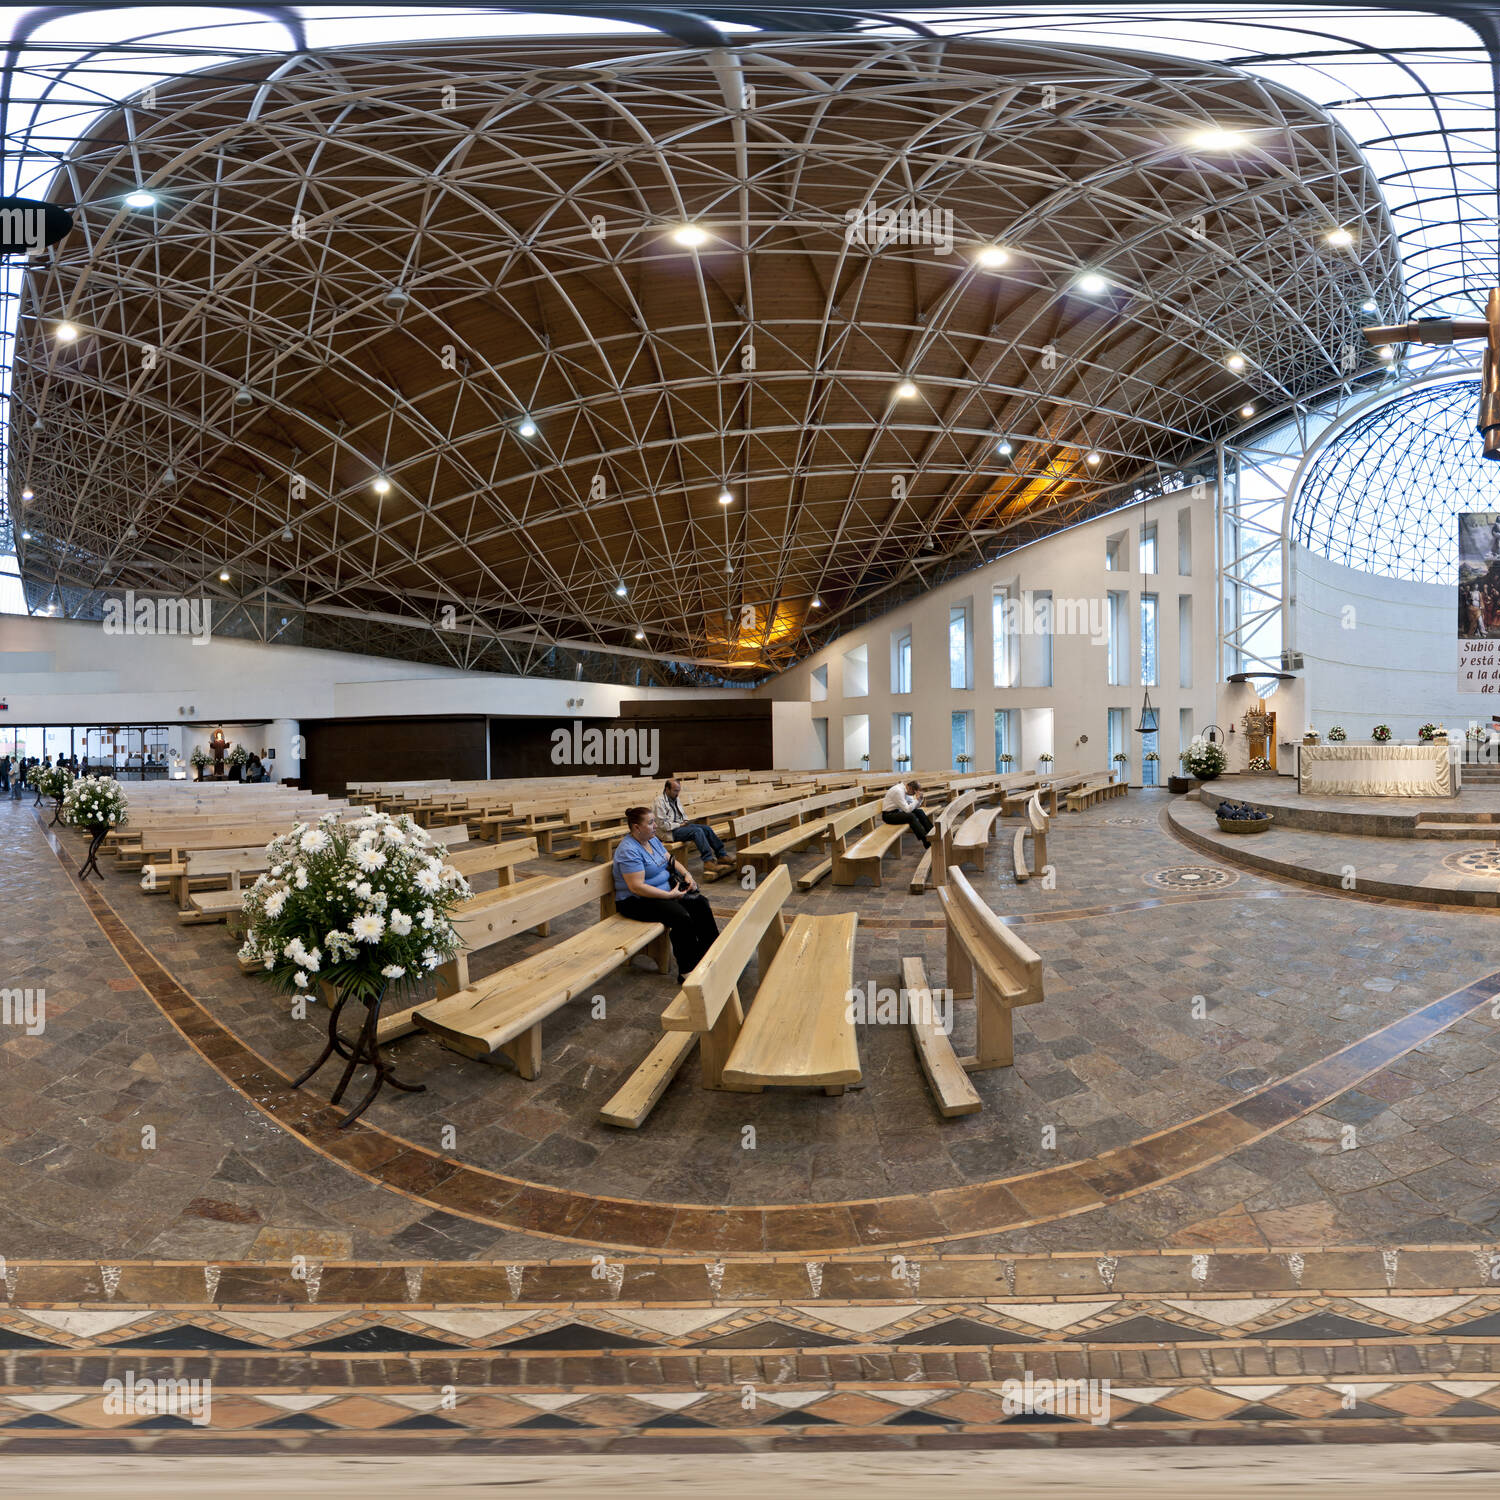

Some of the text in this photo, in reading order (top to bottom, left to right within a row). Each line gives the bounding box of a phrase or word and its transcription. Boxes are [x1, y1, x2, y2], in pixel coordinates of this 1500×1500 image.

[1464, 642, 1494, 652] Subió
[1460, 657, 1467, 667] y
[1470, 655, 1494, 666] está
[1466, 671, 1473, 680] a
[1478, 670, 1488, 680] la
[1481, 684, 1494, 694] de
